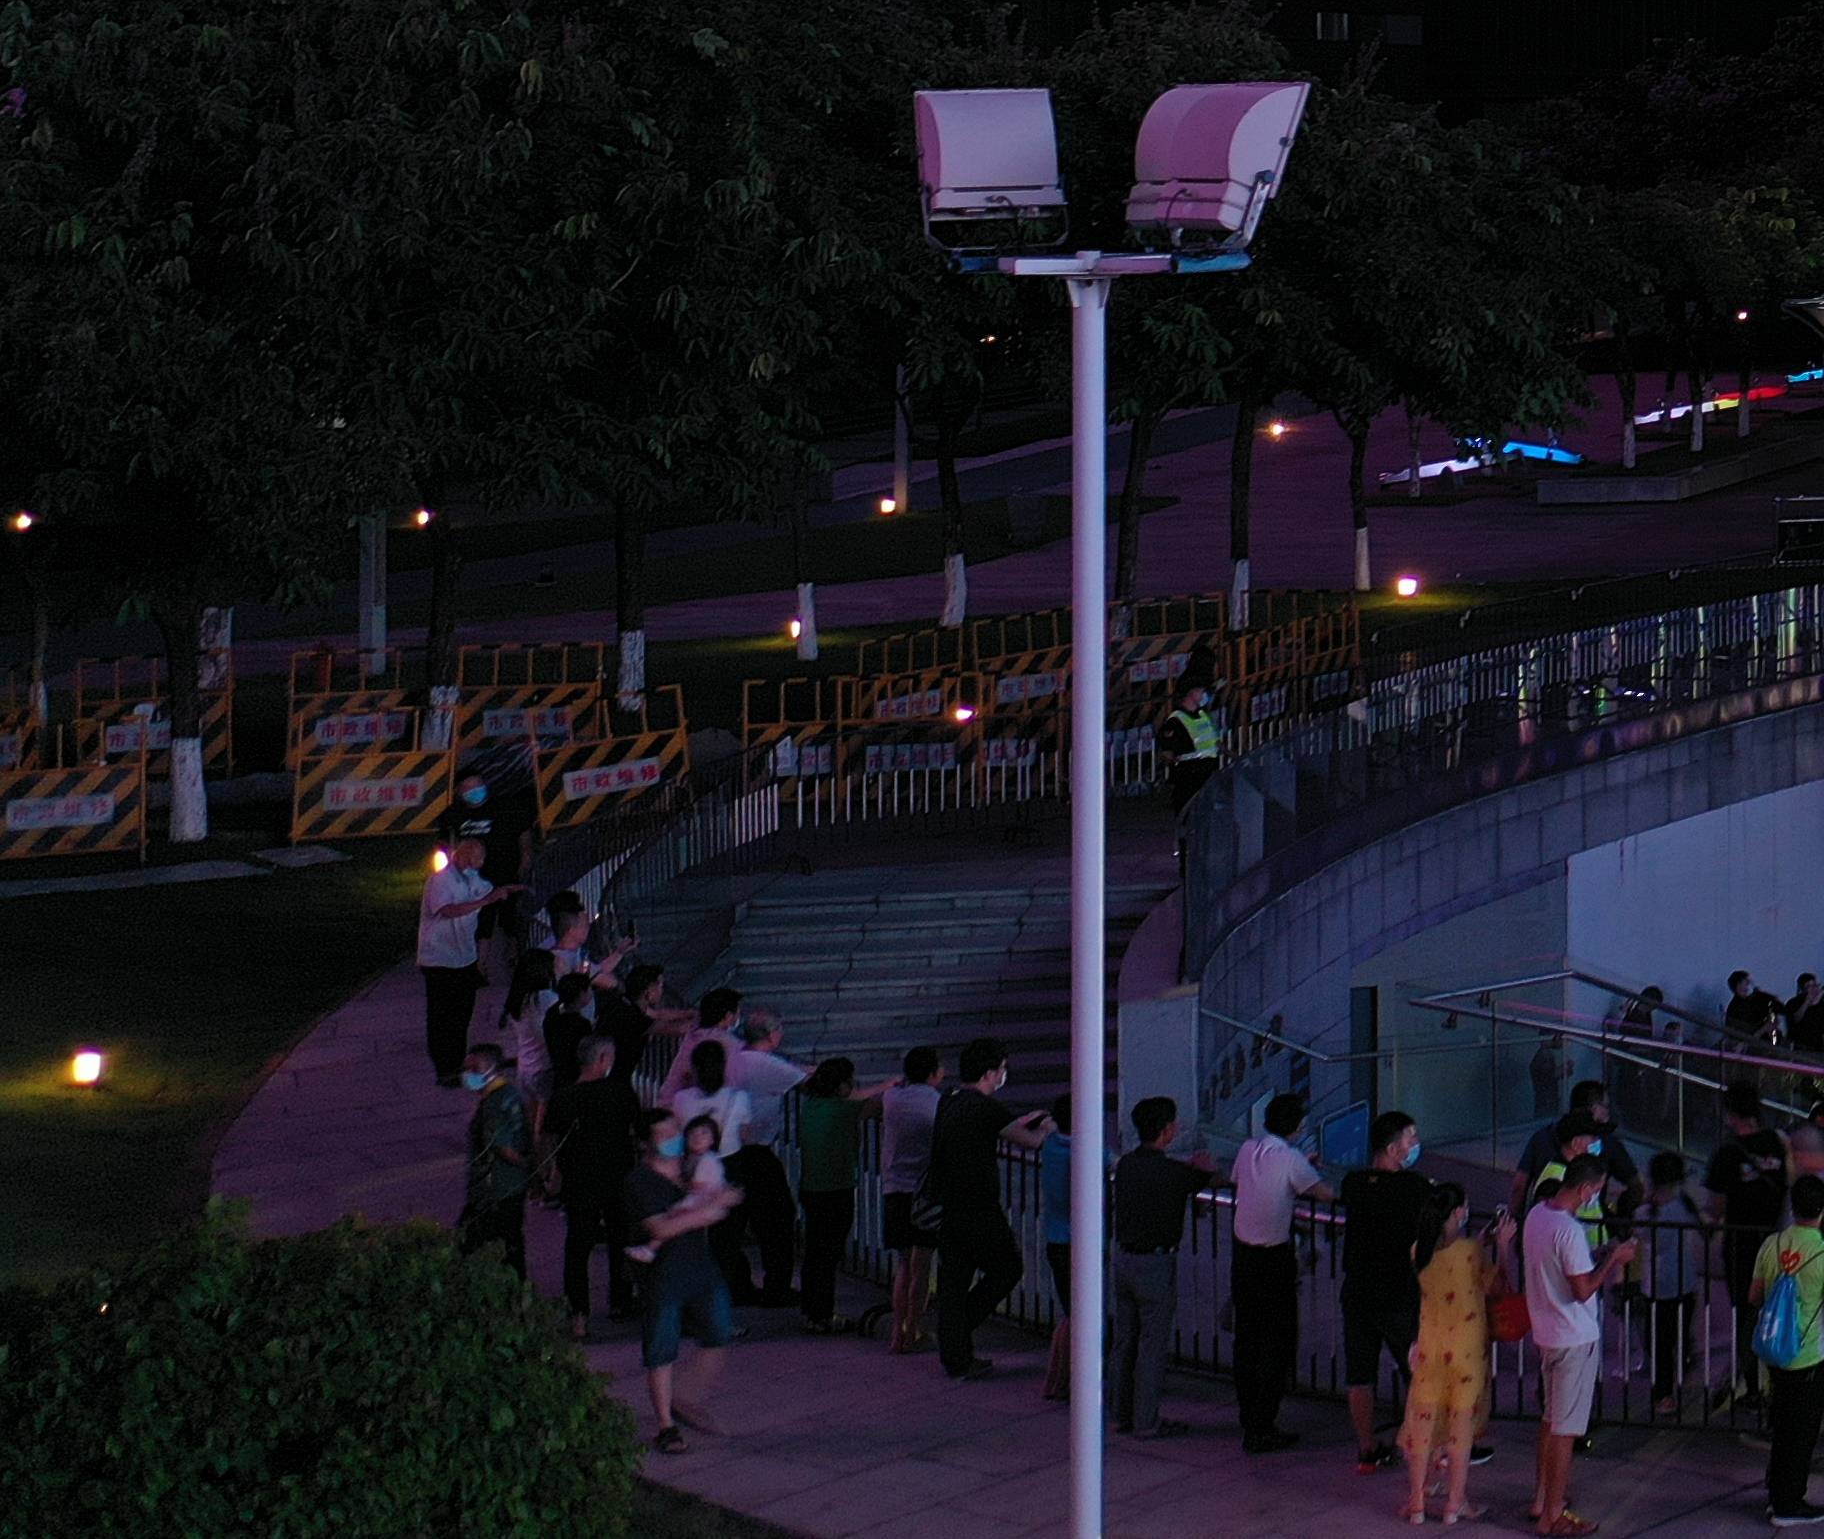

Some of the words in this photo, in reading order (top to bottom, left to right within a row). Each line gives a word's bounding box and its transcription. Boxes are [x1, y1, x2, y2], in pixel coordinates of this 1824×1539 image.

[573, 765, 657, 791] 市政维修
[331, 784, 418, 803] 市政维修
